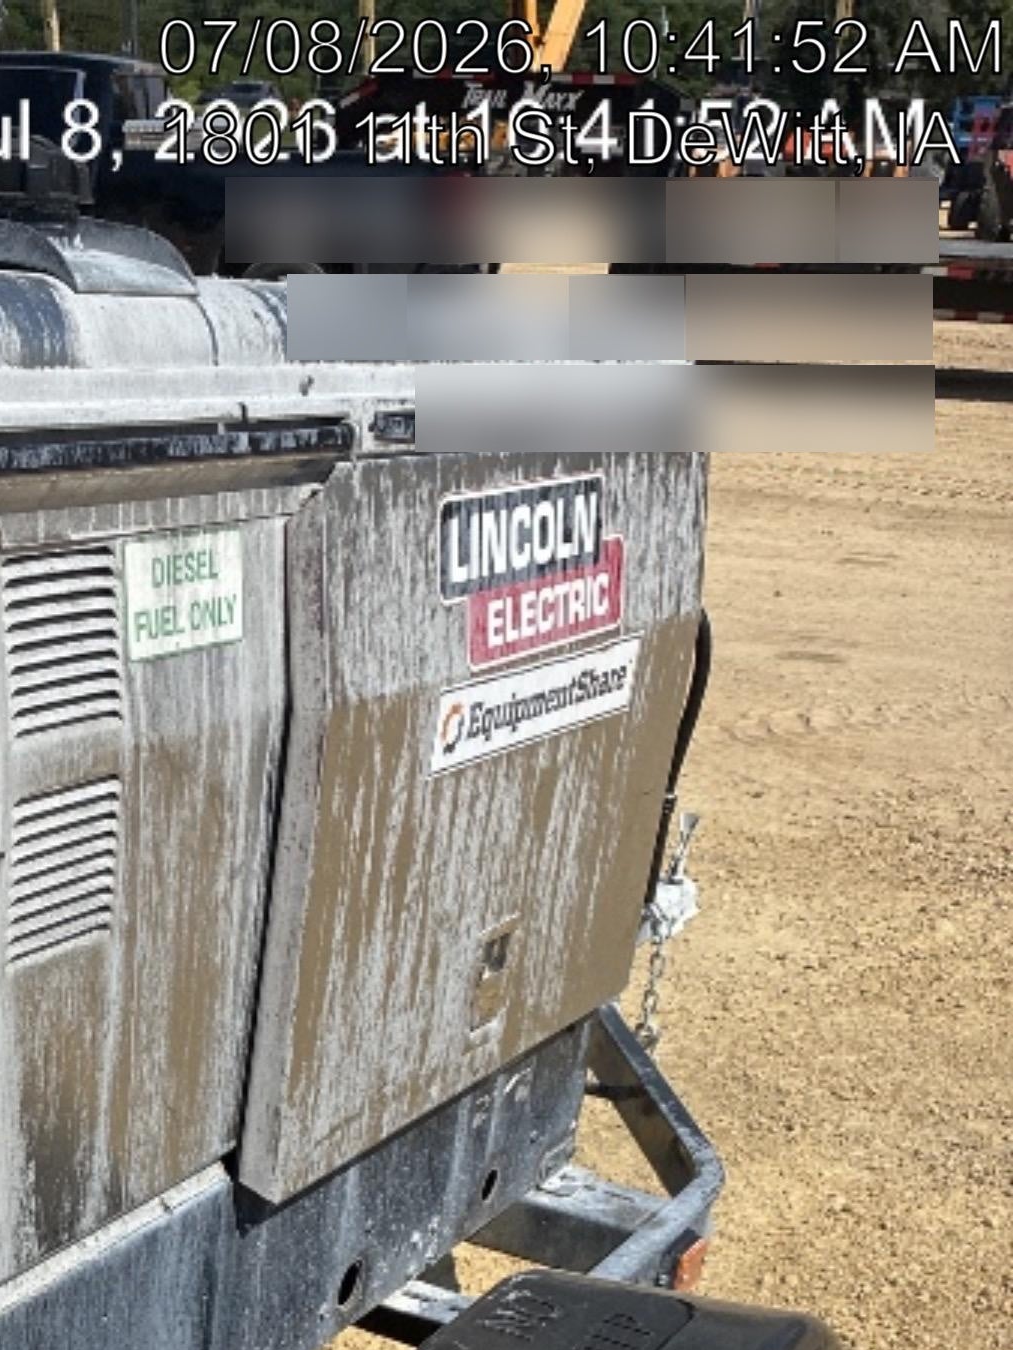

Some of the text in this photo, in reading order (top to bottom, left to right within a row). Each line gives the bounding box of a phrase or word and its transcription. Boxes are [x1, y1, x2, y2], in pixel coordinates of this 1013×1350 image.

[151, 548, 219, 589] DIESEL
[450, 491, 598, 583] LINCOLN
[134, 593, 237, 643] FUEL ONLY
[487, 572, 610, 648] ELECTRIC
[465, 664, 629, 742] EquipmentShare
